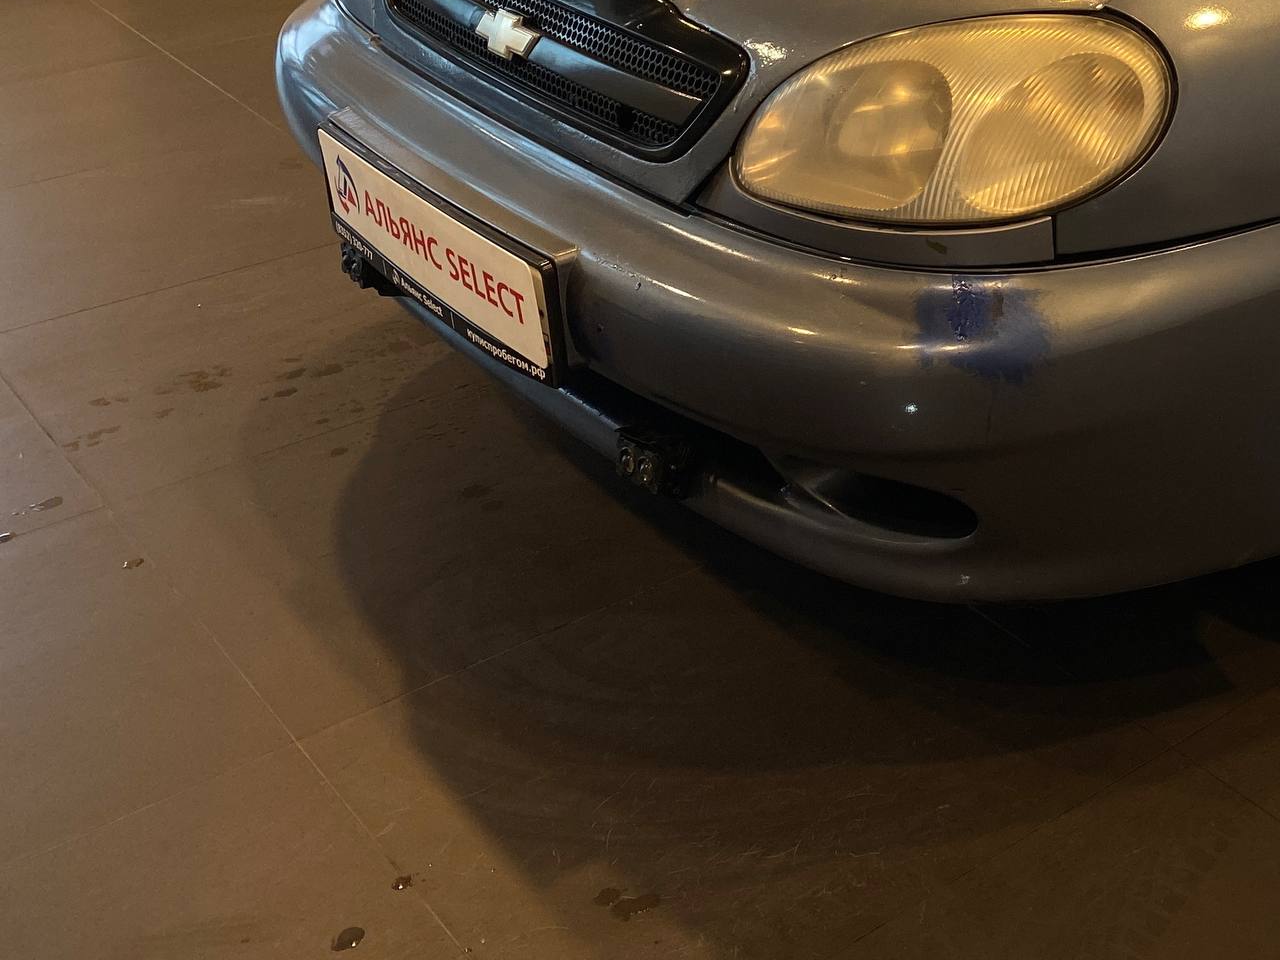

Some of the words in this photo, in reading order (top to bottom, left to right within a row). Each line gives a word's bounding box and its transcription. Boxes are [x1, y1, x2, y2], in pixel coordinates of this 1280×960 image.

[364, 190, 443, 271] АЛЬЯНС
[445, 248, 525, 325] SELECT
[422, 294, 443, 317] Select
[467, 328, 546, 380] куписпробегом.рф
